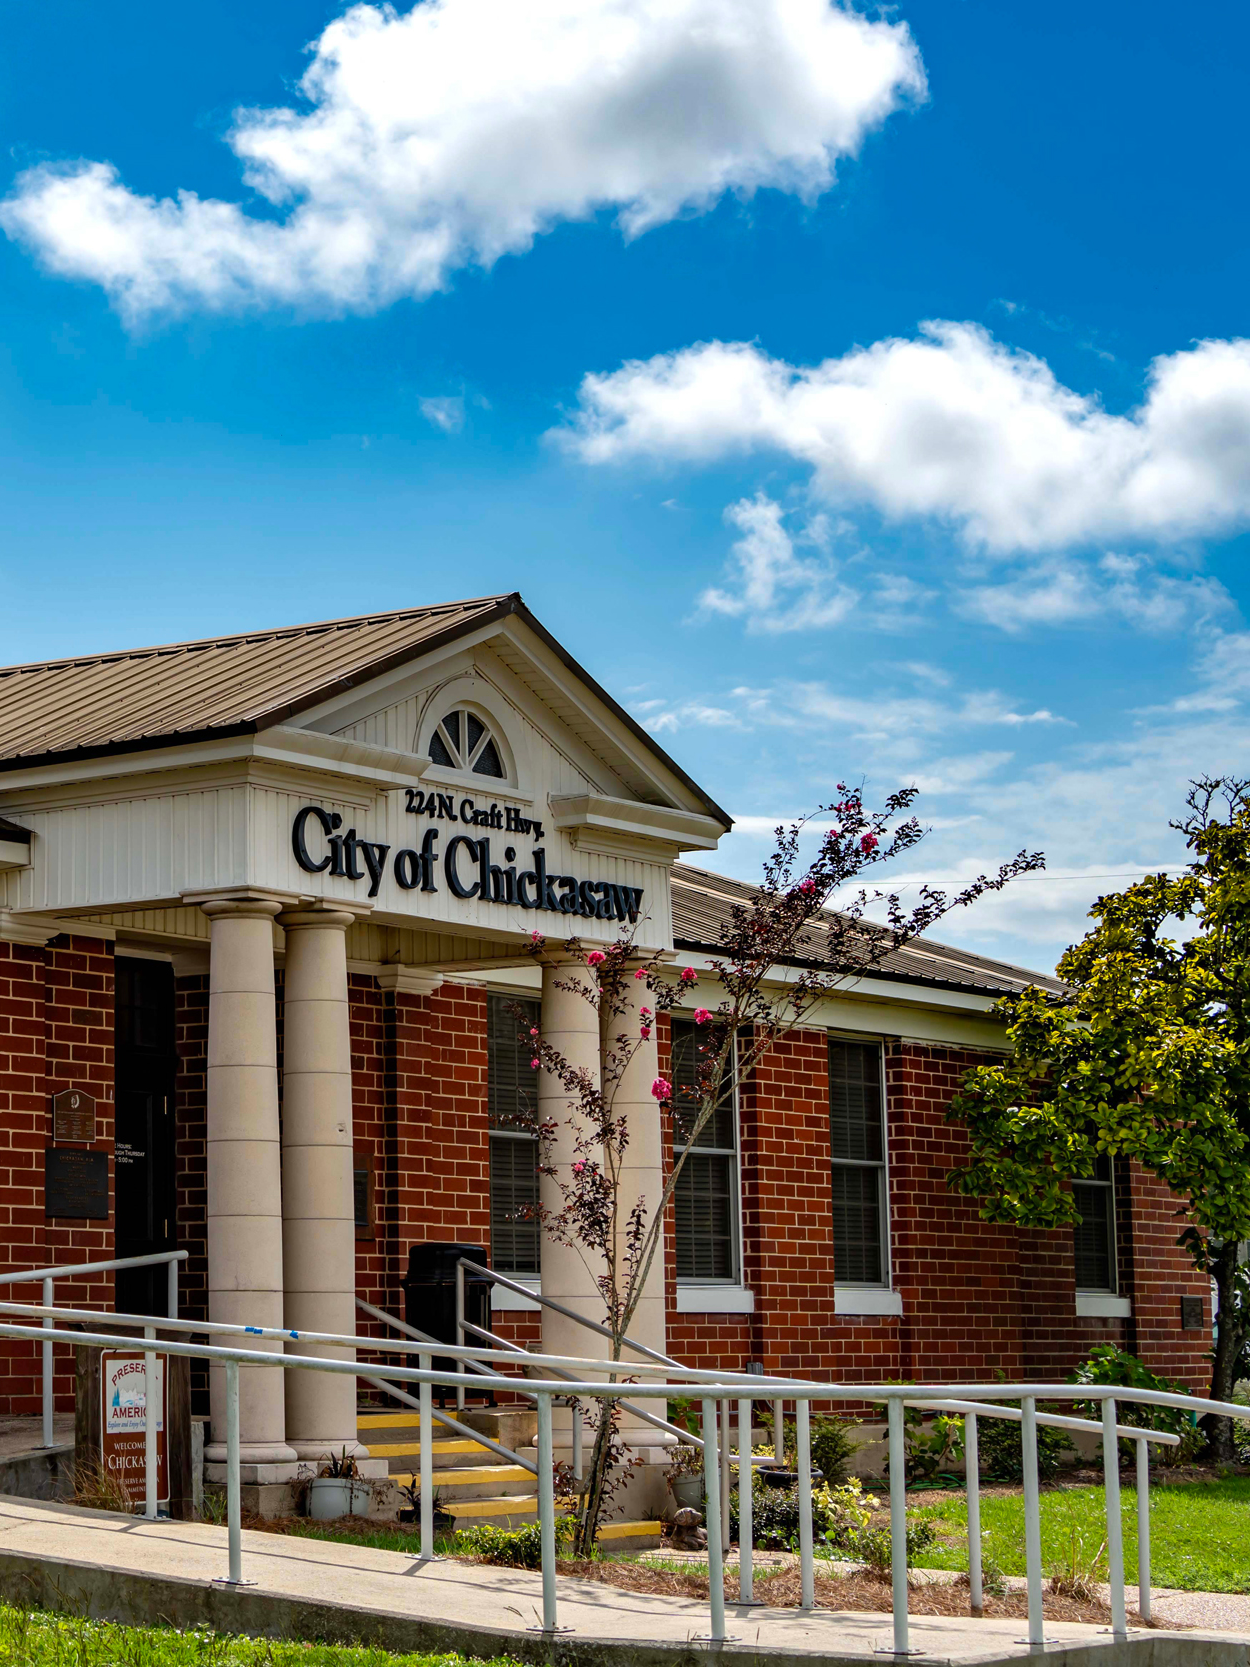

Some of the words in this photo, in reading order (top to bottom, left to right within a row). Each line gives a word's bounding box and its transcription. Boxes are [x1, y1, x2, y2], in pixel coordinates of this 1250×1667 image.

[460, 799, 504, 830] Craft
[504, 806, 545, 842] Hwy.
[291, 806, 391, 898] City
[394, 828, 439, 893] of
[445, 835, 645, 925] Chickasaw
[114, 1442, 146, 1451] WELCOME
